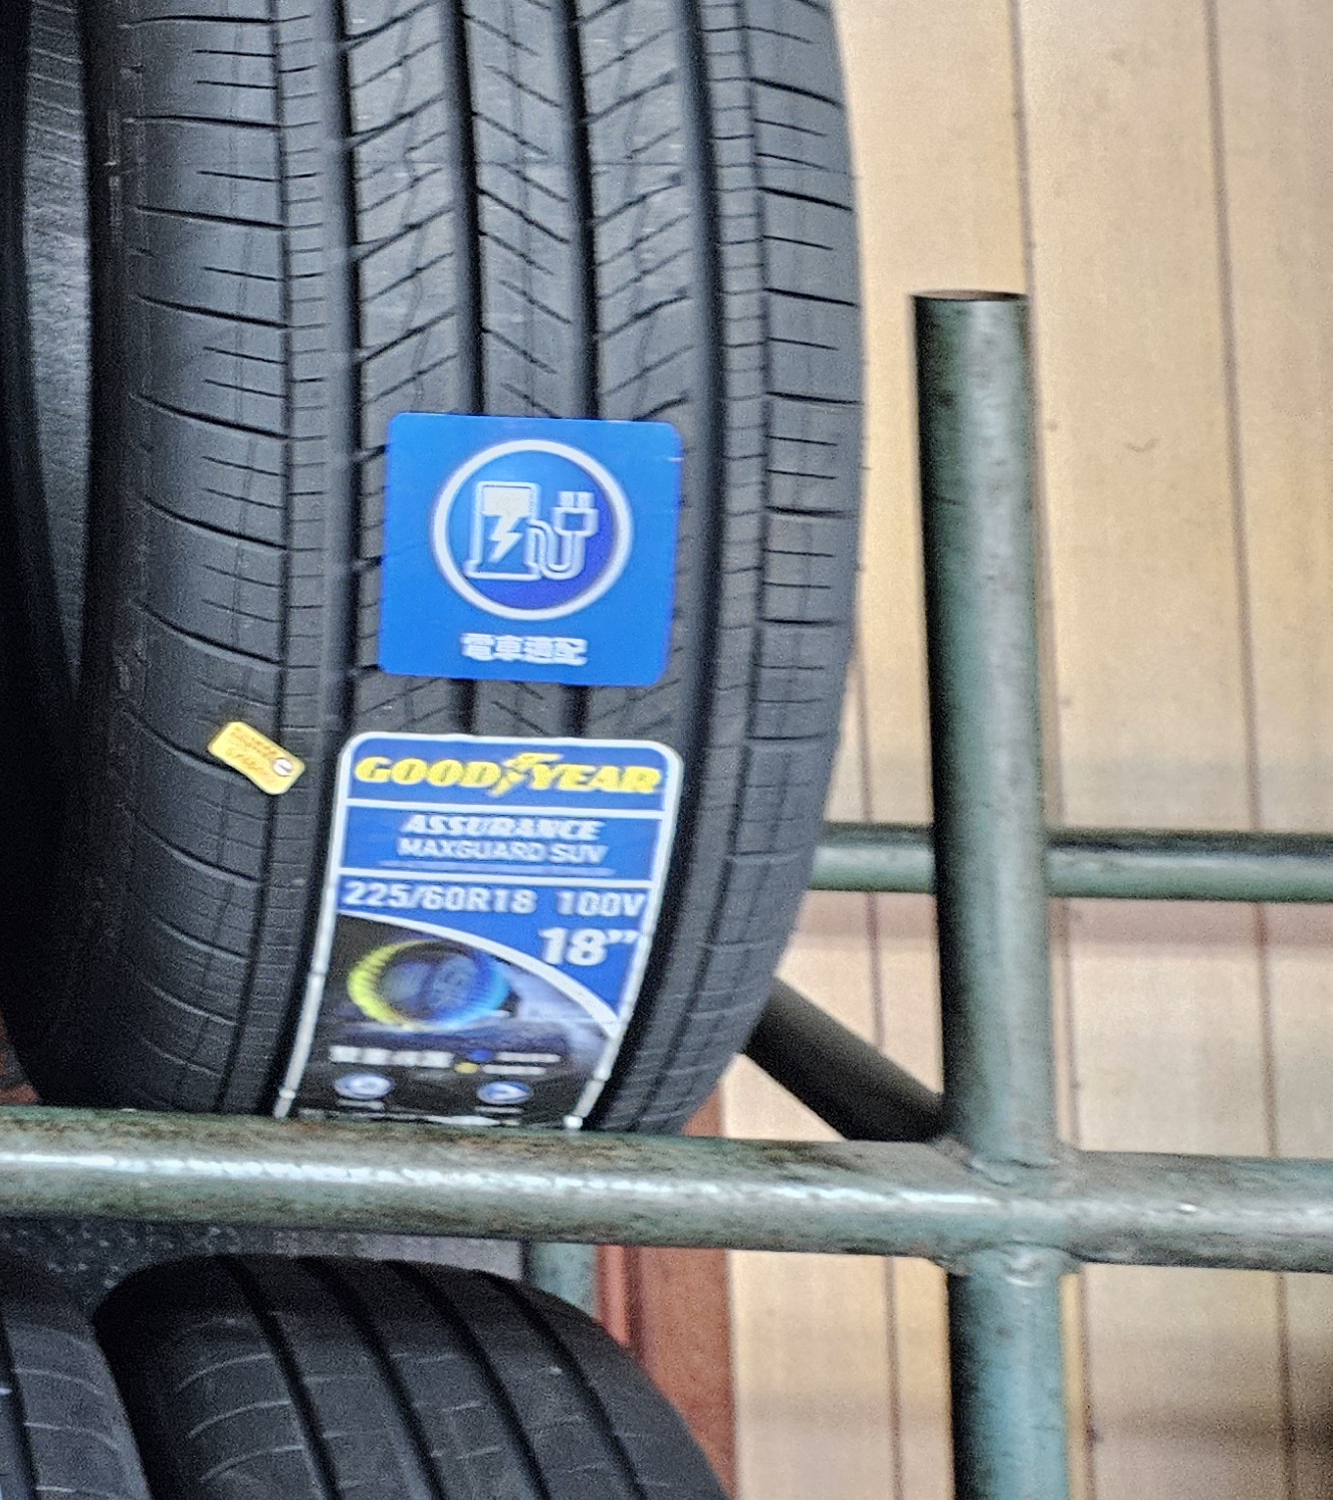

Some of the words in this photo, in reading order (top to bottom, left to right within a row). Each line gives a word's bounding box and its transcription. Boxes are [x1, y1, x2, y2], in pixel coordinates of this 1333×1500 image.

[354, 752, 661, 797] GOODYEAR
[399, 814, 605, 840] ASSURANCE
[397, 837, 546, 862] MAXGUARD
[548, 843, 608, 864] SUV
[344, 880, 537, 914] 225/60R18
[556, 890, 645, 917] 100V
